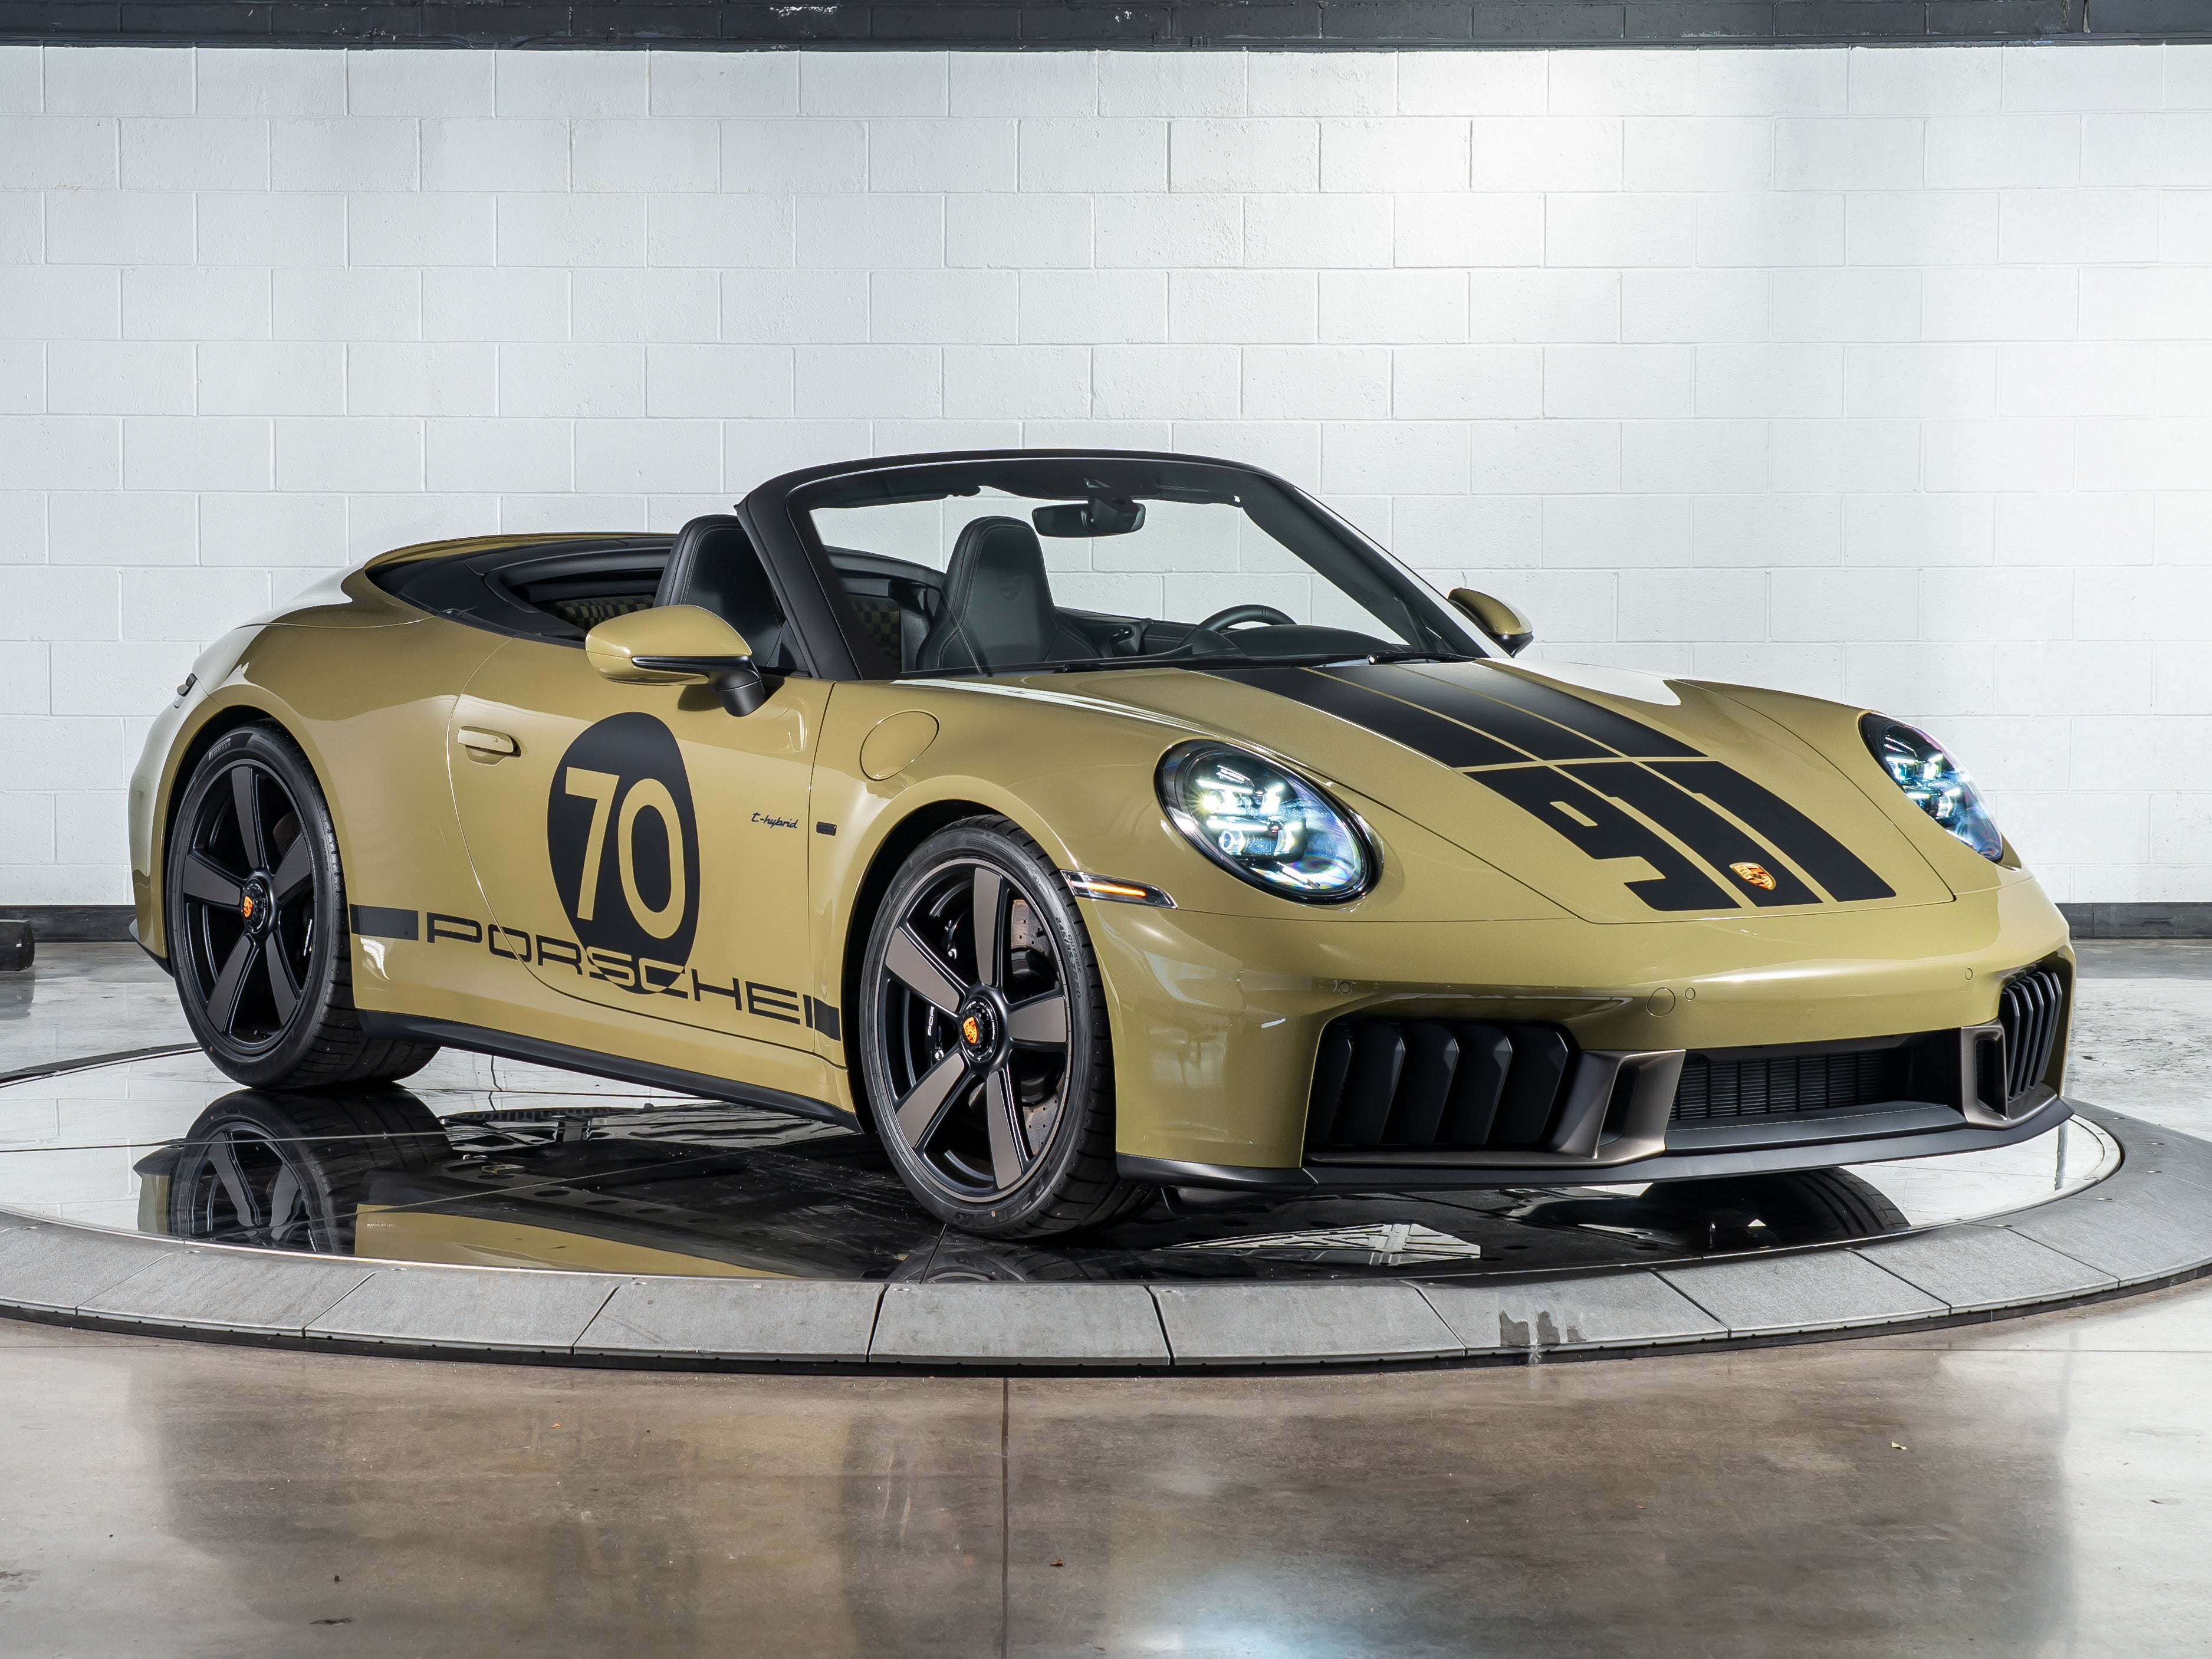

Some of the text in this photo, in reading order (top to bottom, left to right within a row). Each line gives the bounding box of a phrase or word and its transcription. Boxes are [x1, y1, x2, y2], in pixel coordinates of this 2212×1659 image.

[209, 738, 231, 761] PIRELLI
[321, 839, 330, 872] OUTSIDE
[564, 767, 686, 939] 70
[1462, 760, 1897, 912] 911
[426, 912, 801, 1026] PORSCHE
[1067, 934, 1082, 974] OUTSIDE
